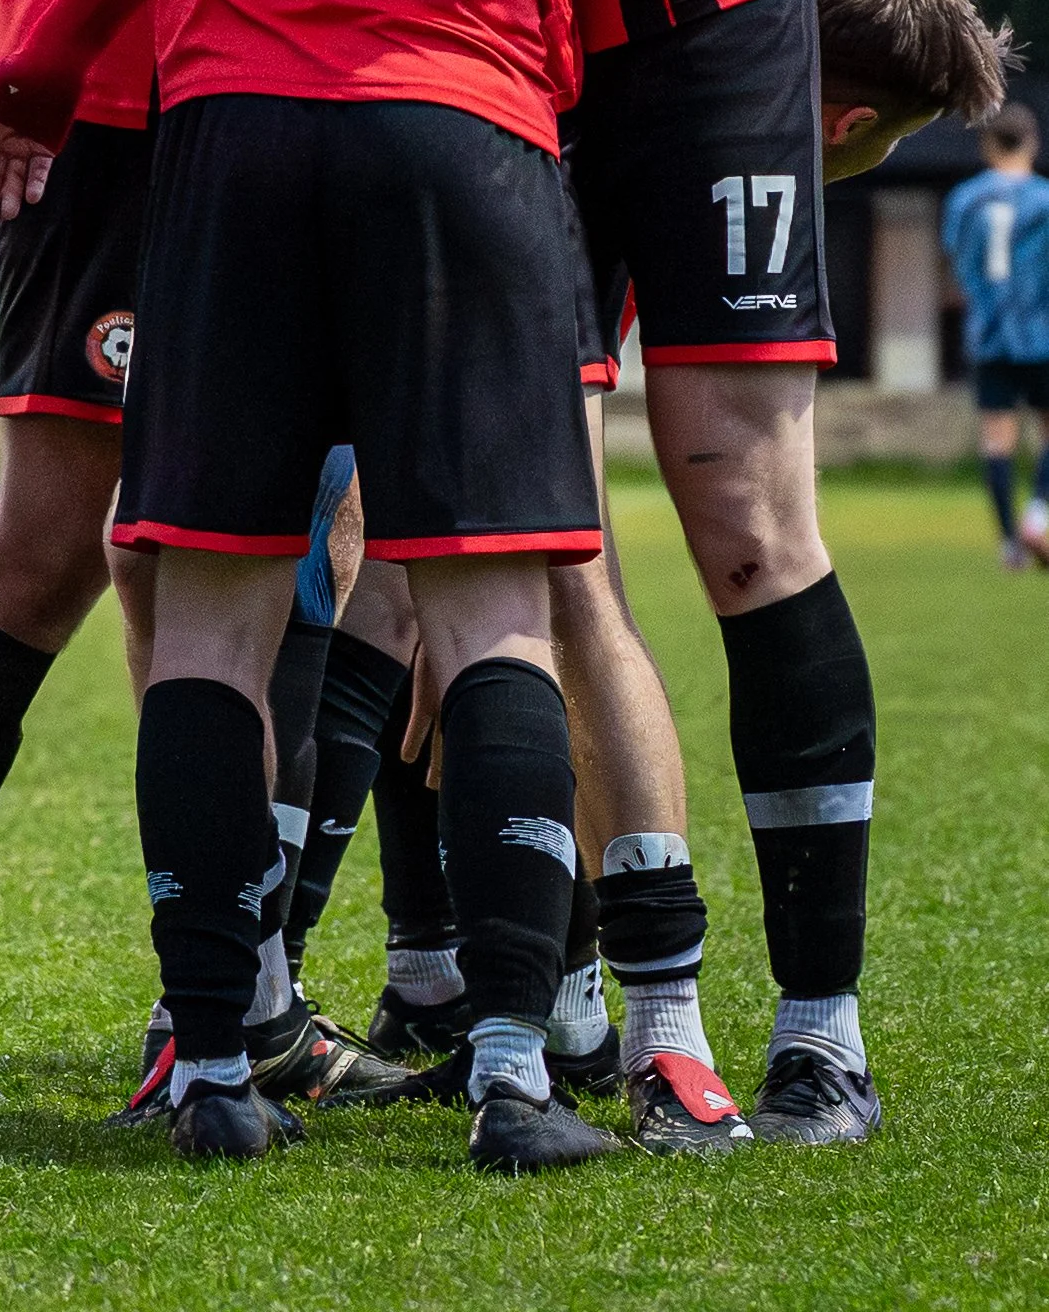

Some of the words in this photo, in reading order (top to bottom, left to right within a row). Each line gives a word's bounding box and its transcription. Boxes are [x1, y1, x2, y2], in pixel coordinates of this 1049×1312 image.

[711, 175, 796, 275] 17
[984, 202, 1015, 282] 1
[722, 293, 798, 310] VERVE
